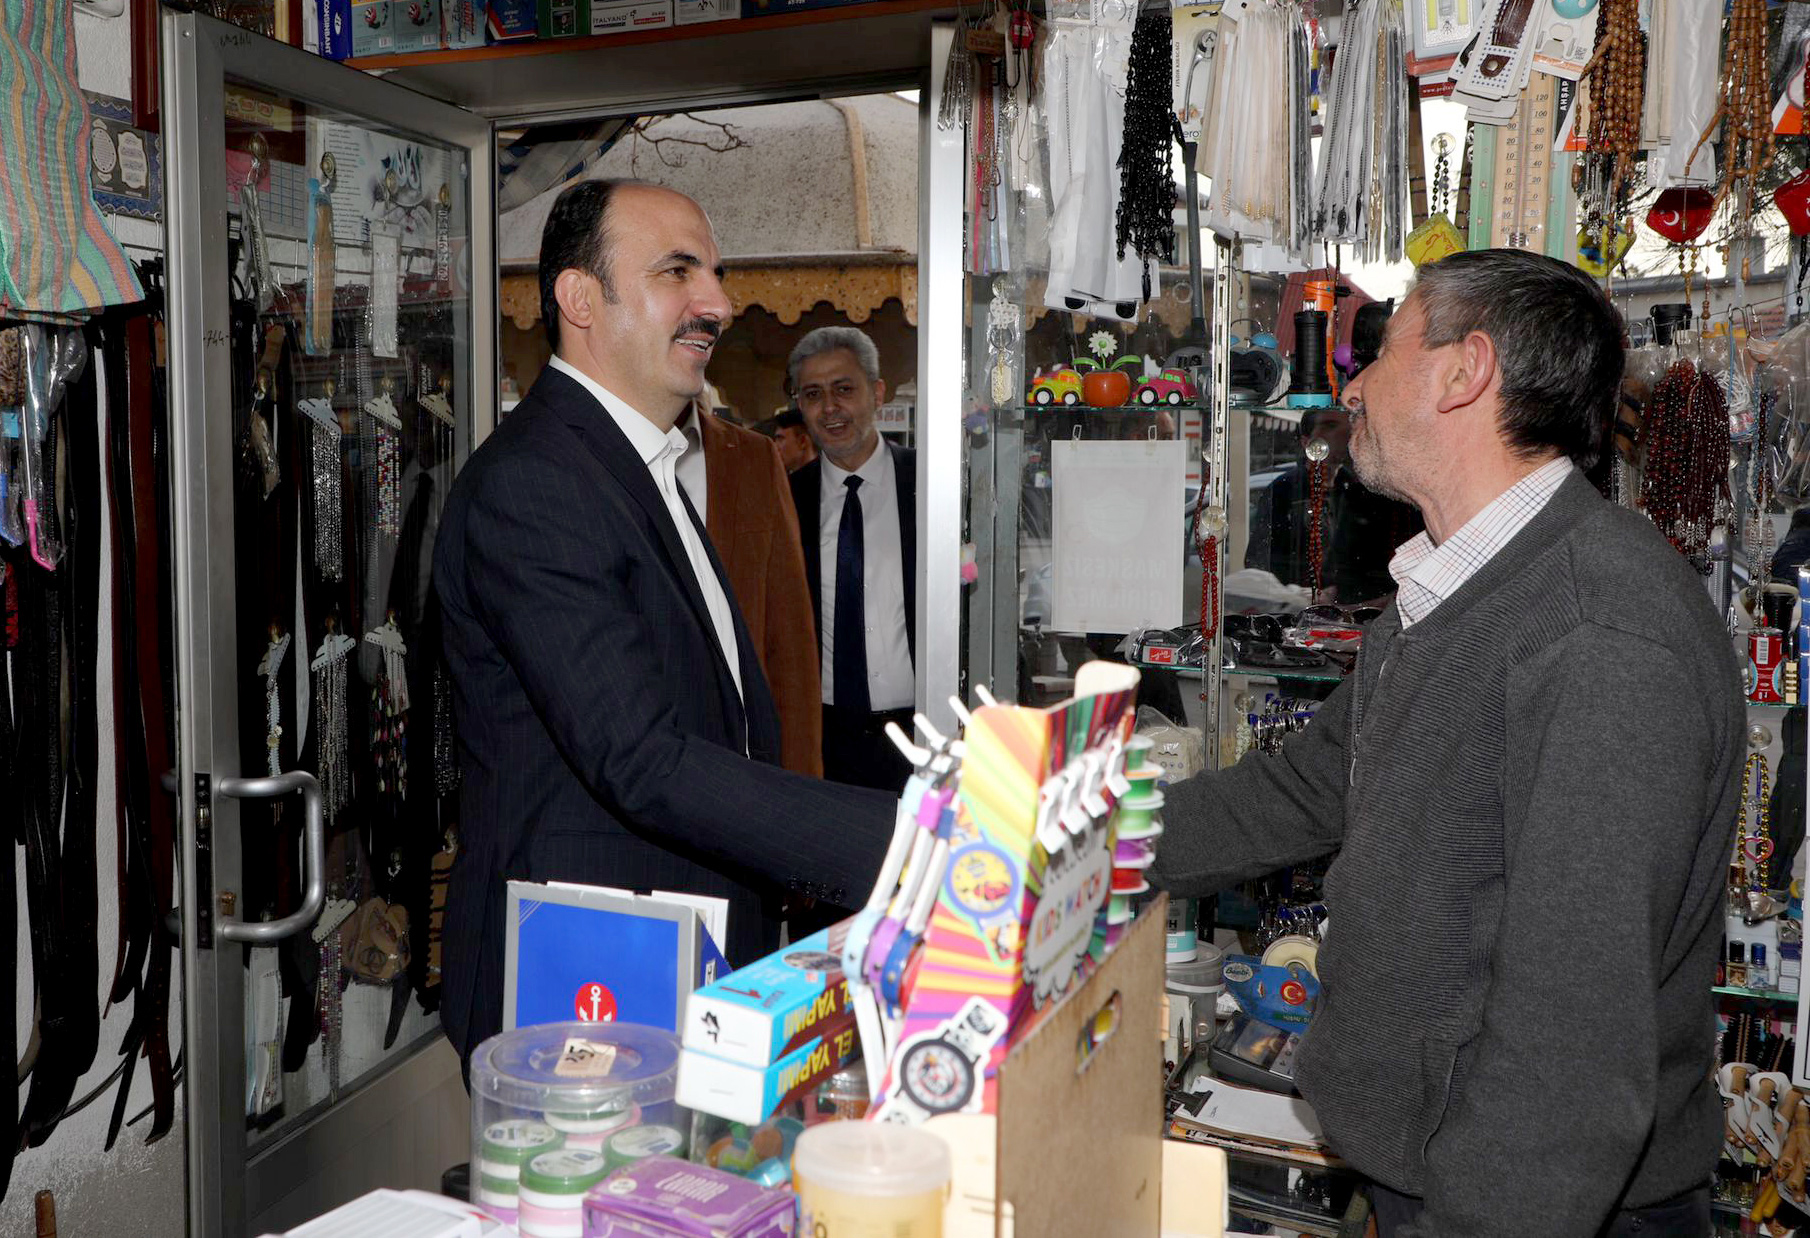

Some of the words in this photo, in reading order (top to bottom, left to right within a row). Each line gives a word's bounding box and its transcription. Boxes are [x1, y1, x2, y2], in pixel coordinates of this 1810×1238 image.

[1535, 93, 1549, 101] 120
[1559, 80, 1570, 112] AHŞAP
[1534, 110, 1548, 118] 100
[1506, 137, 1516, 145] 20
[1534, 143, 1544, 151] 60
[1506, 152, 1515, 160] 10
[783, 987, 837, 1043] YAPIMI
[834, 1029, 854, 1058] EL
[776, 1042, 830, 1098] YAPIMI
